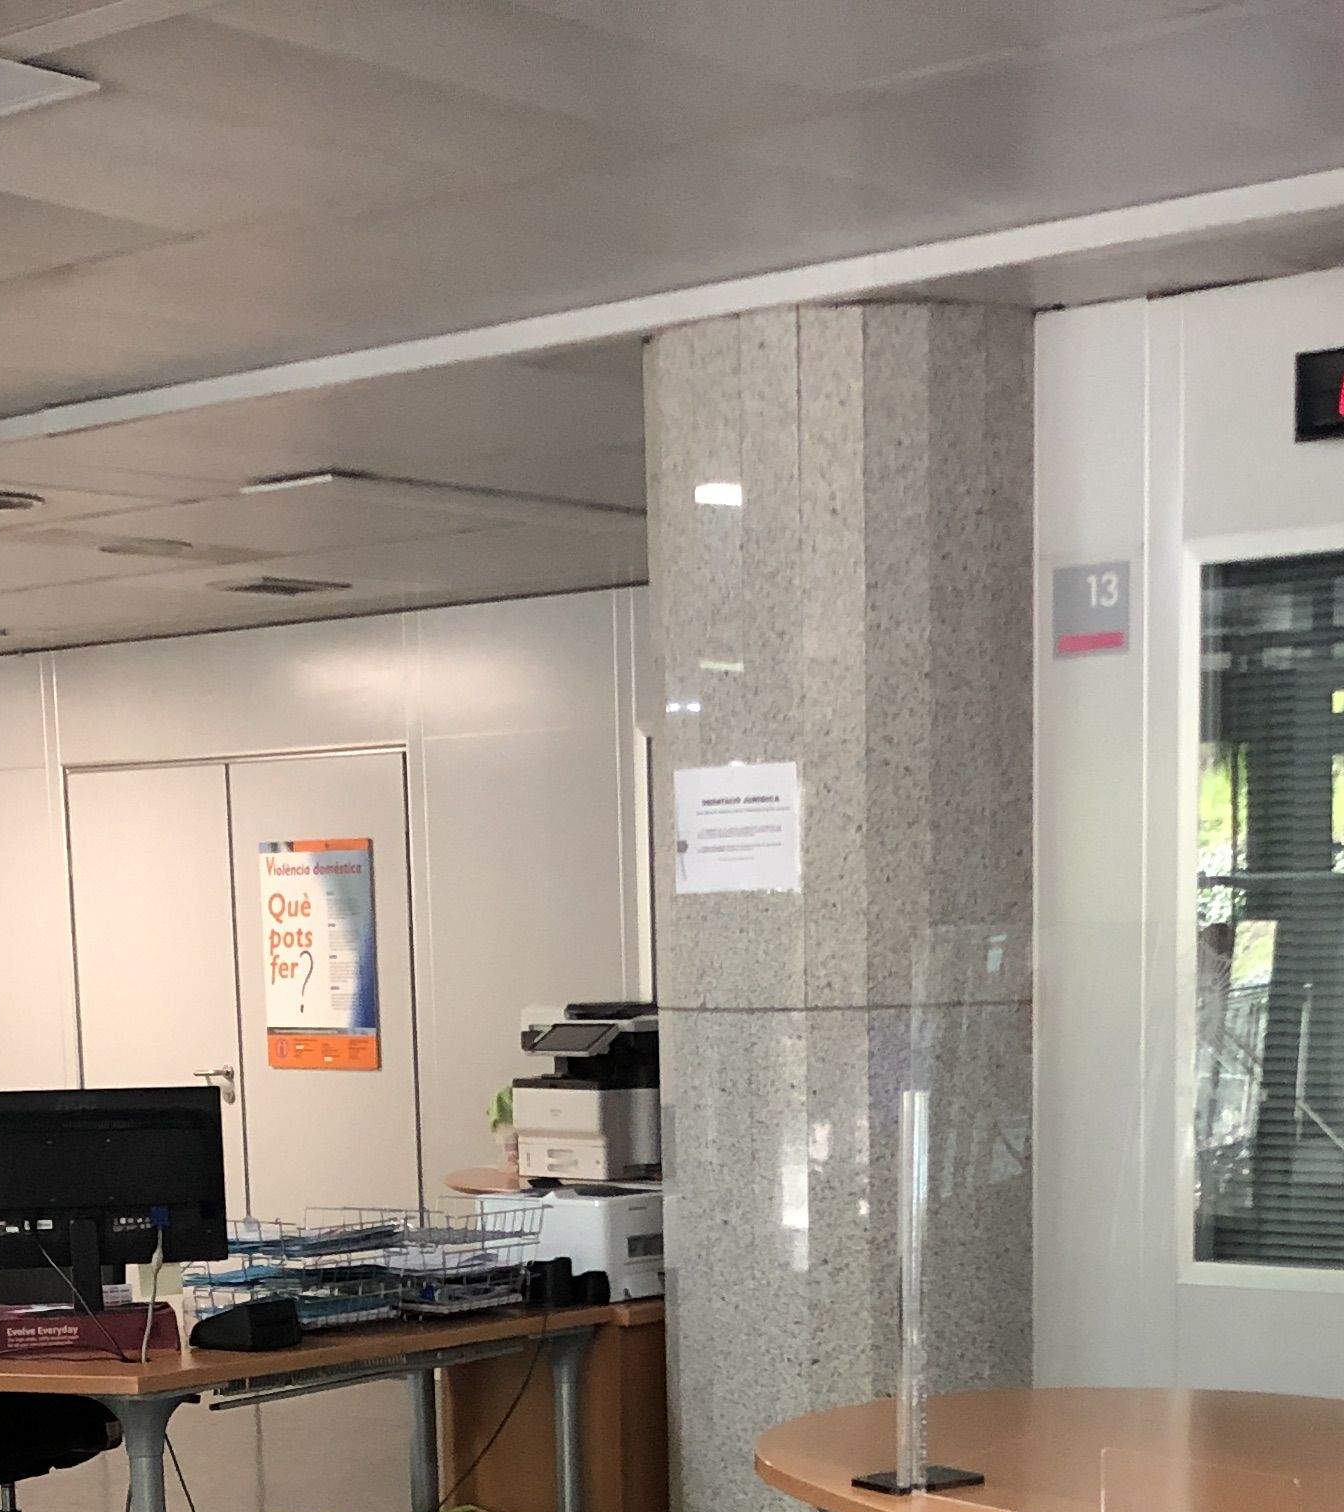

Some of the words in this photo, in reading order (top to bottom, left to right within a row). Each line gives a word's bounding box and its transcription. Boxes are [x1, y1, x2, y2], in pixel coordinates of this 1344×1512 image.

[1086, 572, 1119, 608] 13
[266, 857, 311, 876] Violència
[268, 892, 312, 924] Què
[269, 928, 313, 956] pots
[7, 1328, 36, 1336] Evolve
[38, 1325, 79, 1336] Everyday
